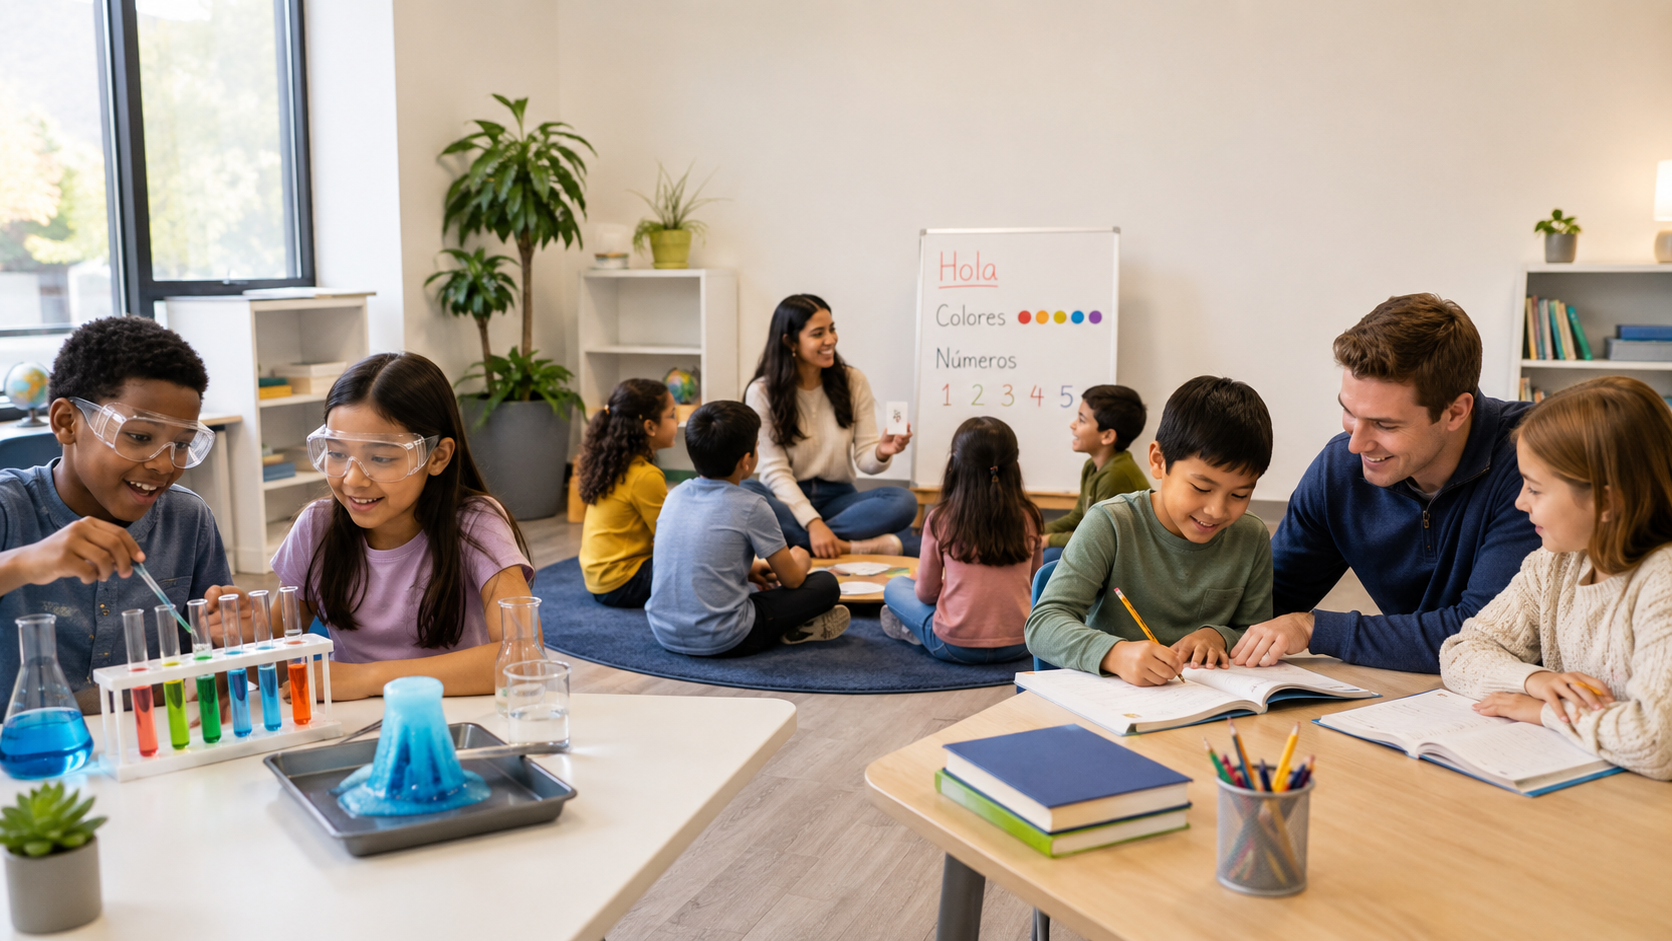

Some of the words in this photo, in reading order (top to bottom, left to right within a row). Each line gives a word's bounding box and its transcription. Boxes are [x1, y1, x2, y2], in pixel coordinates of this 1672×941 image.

[940, 250, 998, 281] Hola
[936, 303, 1006, 327] Colores
[936, 347, 1017, 369] Números
[942, 383, 951, 406] 1
[971, 384, 985, 406] 2
[1001, 384, 1015, 407] 3
[1030, 384, 1044, 407] 4
[1060, 385, 1073, 408] 5
